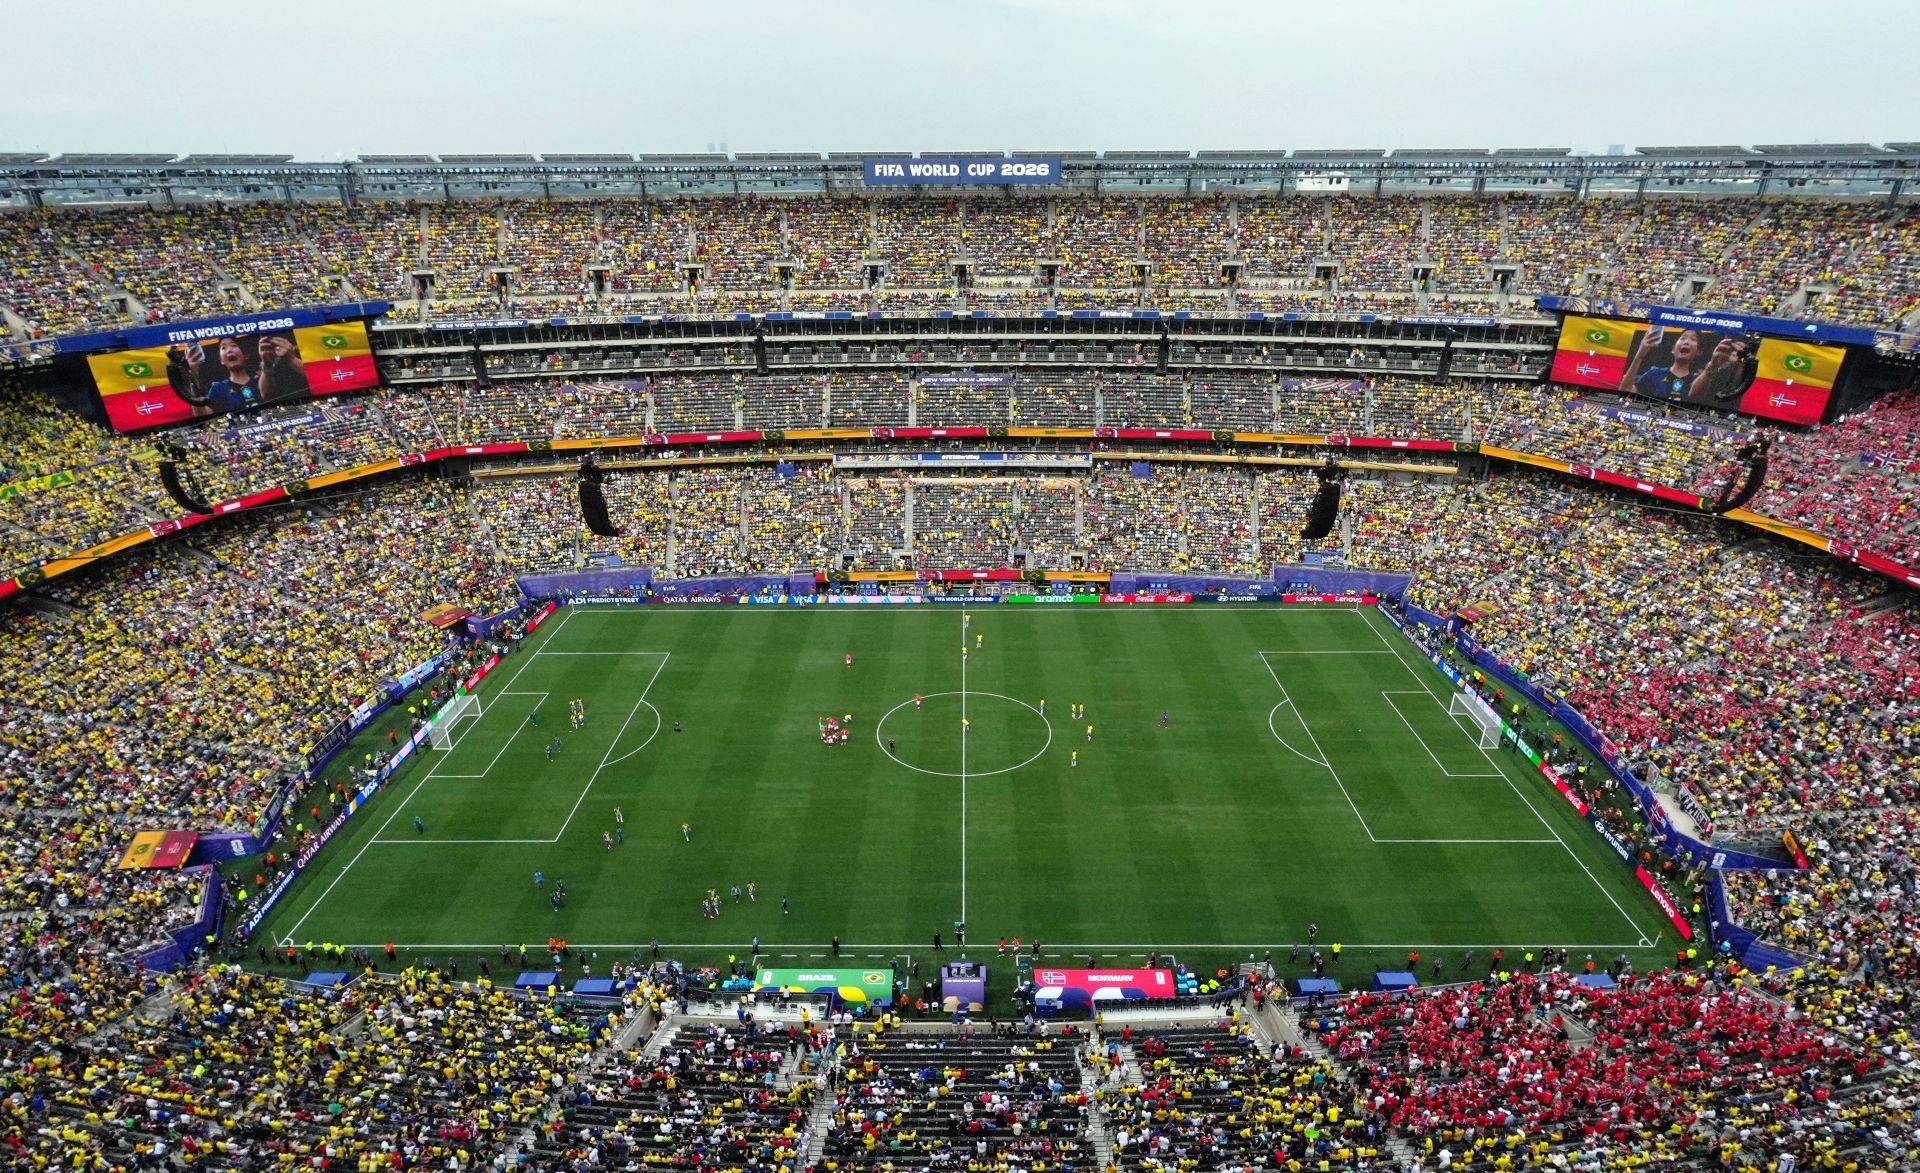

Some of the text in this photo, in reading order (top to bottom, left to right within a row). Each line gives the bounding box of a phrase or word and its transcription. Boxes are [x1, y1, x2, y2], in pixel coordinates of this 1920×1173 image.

[874, 163, 1050, 177] FIFA WORLD CUP 2026
[1660, 312, 1743, 328] FIFA WORLD CUP 2026
[168, 317, 294, 342] FIFA WORLD CUP 2026
[253, 423, 276, 434] WORLD
[290, 416, 313, 426] 2026
[1617, 411, 1631, 420] FIFA
[1668, 420, 1693, 431] 2026
[568, 597, 587, 605] ADI
[1035, 595, 1074, 603] aramco
[1104, 595, 1125, 603] Coca-Cola
[1165, 595, 1186, 603] Coca-Cola
[1443, 663, 1454, 678] VISA
[297, 812, 346, 869] QATAR AIRWAYS
[1604, 830, 1629, 861] HYUNDAI
[248, 869, 295, 931] ADI PREDICTSTREET
[1650, 884, 1675, 918] Lenovo
[797, 974, 837, 982] BRAZIL
[1087, 974, 1134, 982] NORWAY
